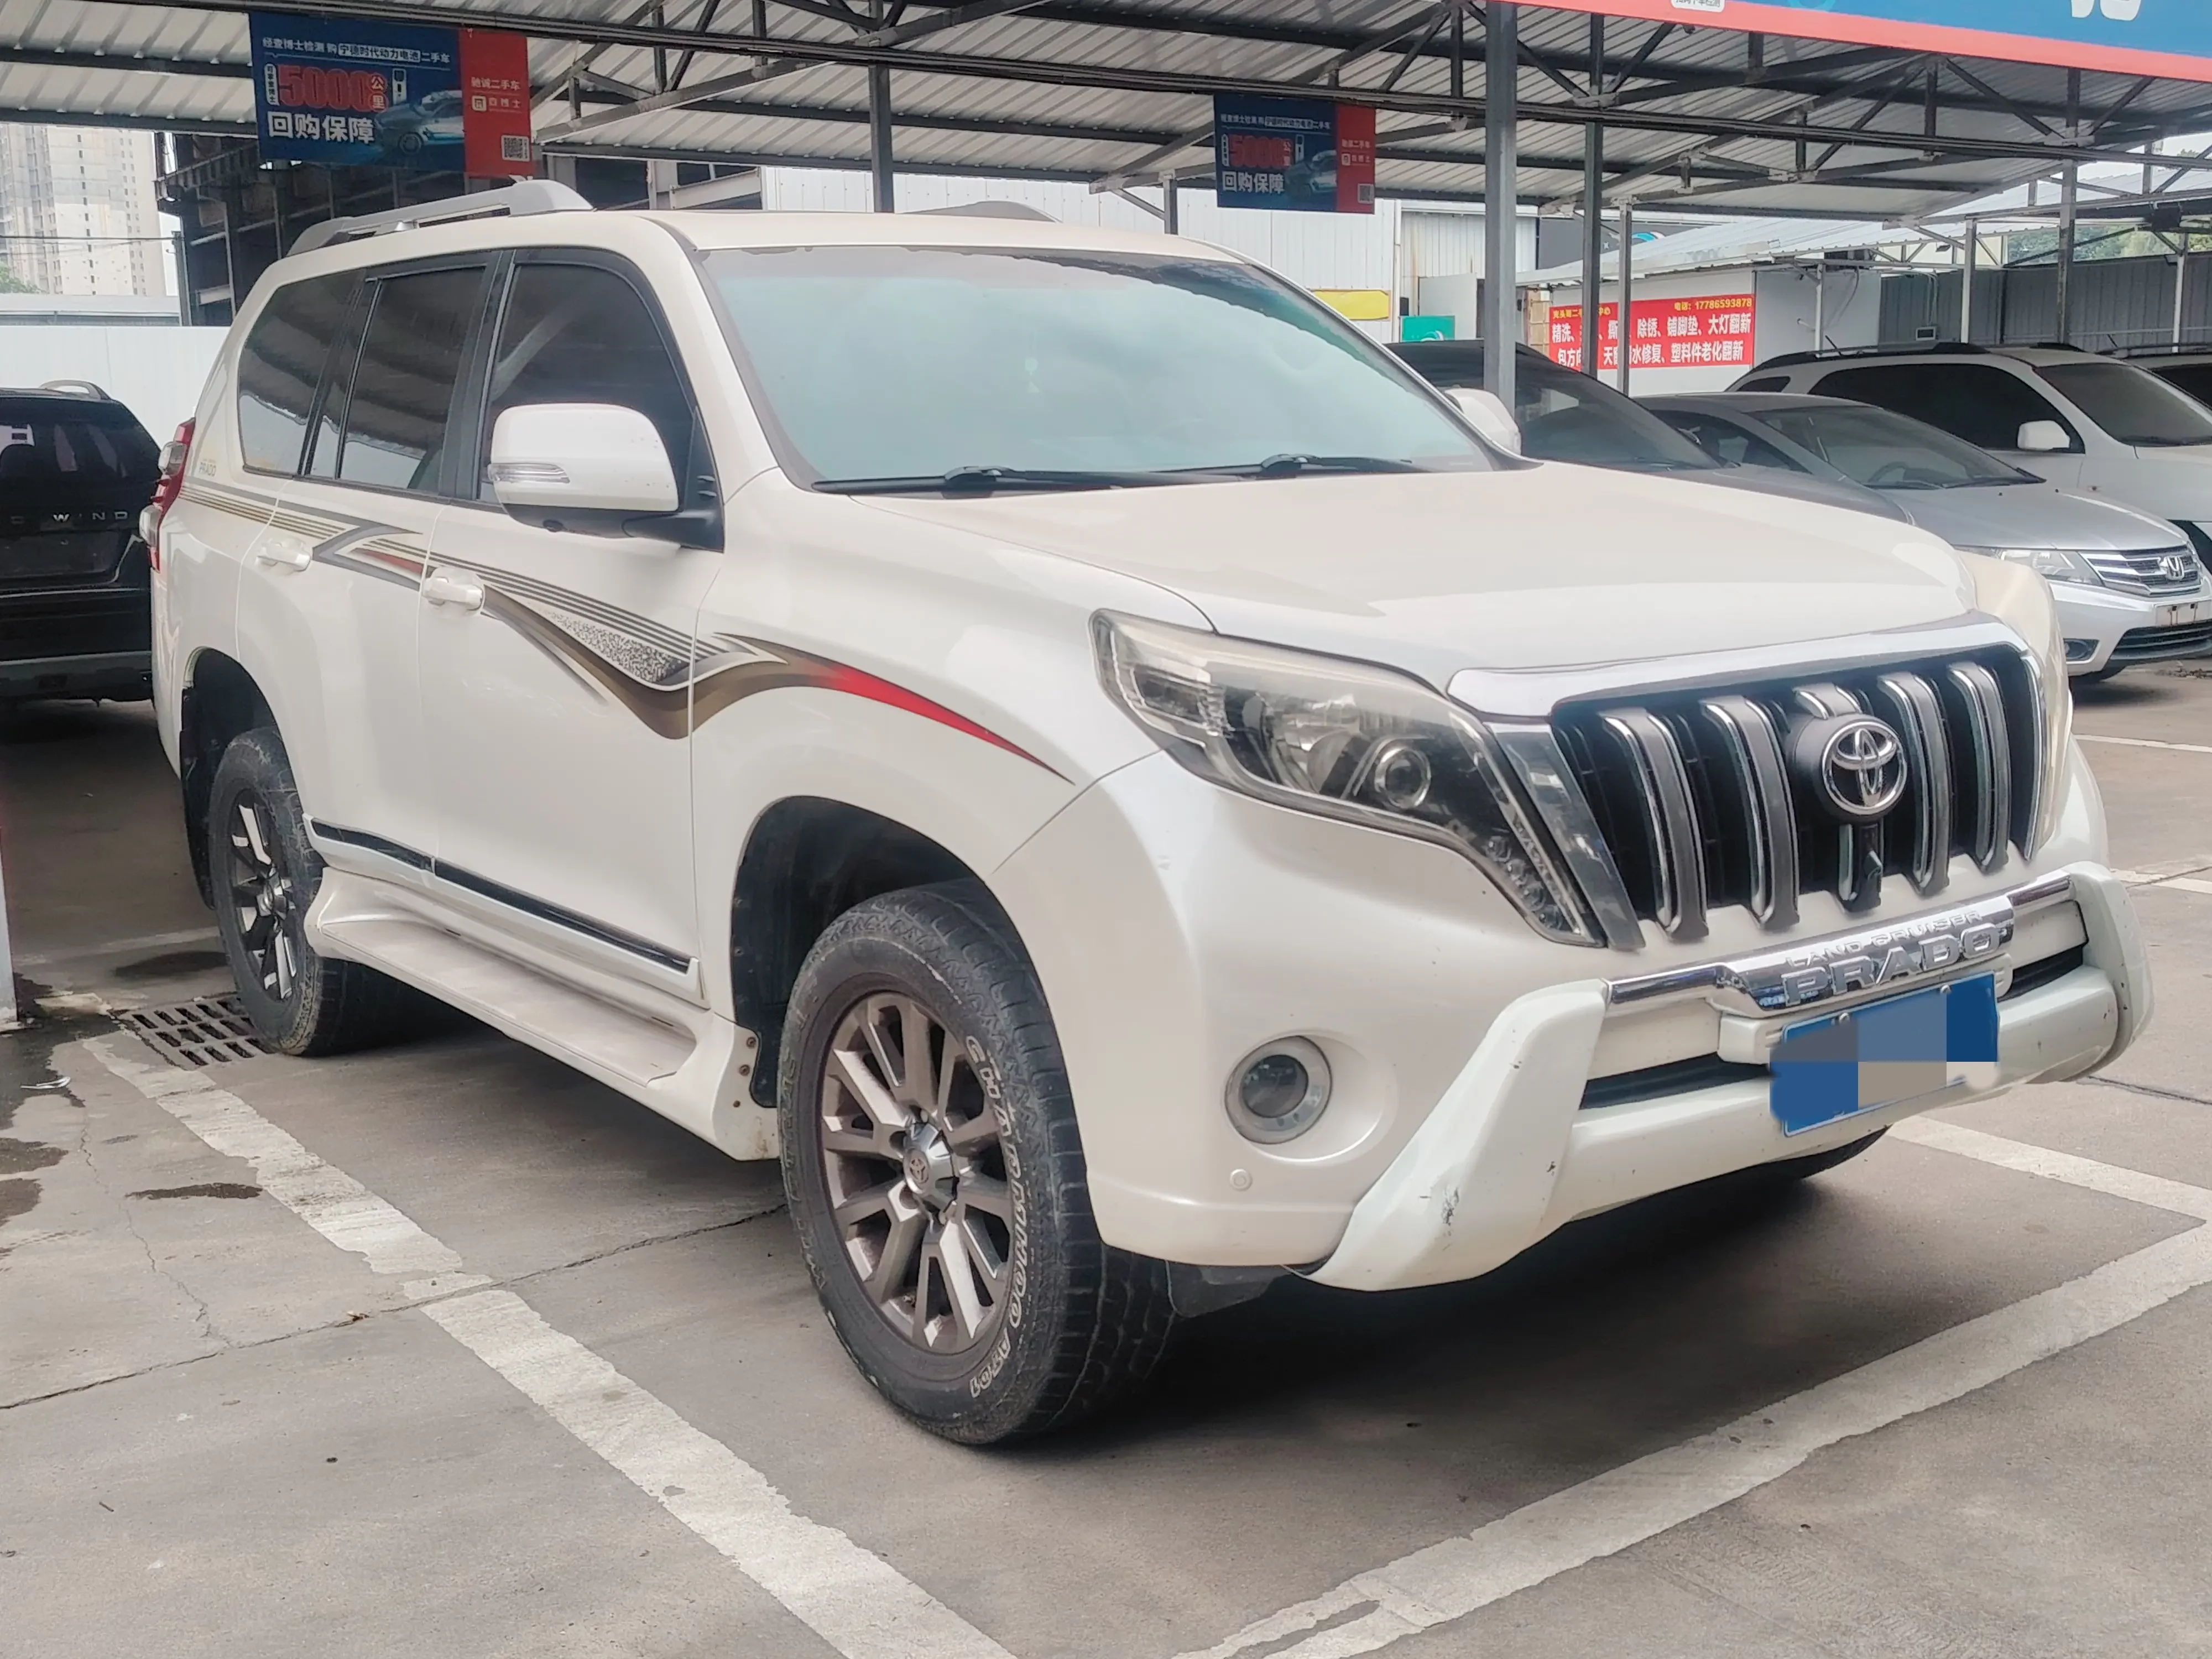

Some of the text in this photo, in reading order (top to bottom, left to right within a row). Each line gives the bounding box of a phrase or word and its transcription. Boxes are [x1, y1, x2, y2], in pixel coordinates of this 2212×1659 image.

[278, 64, 378, 112] 5000
[268, 111, 375, 144] 回购保障
[1222, 171, 1285, 194] 回购保障
[1786, 910, 1983, 968] LAND CRUISER
[1780, 922, 2001, 1007] PRADO
